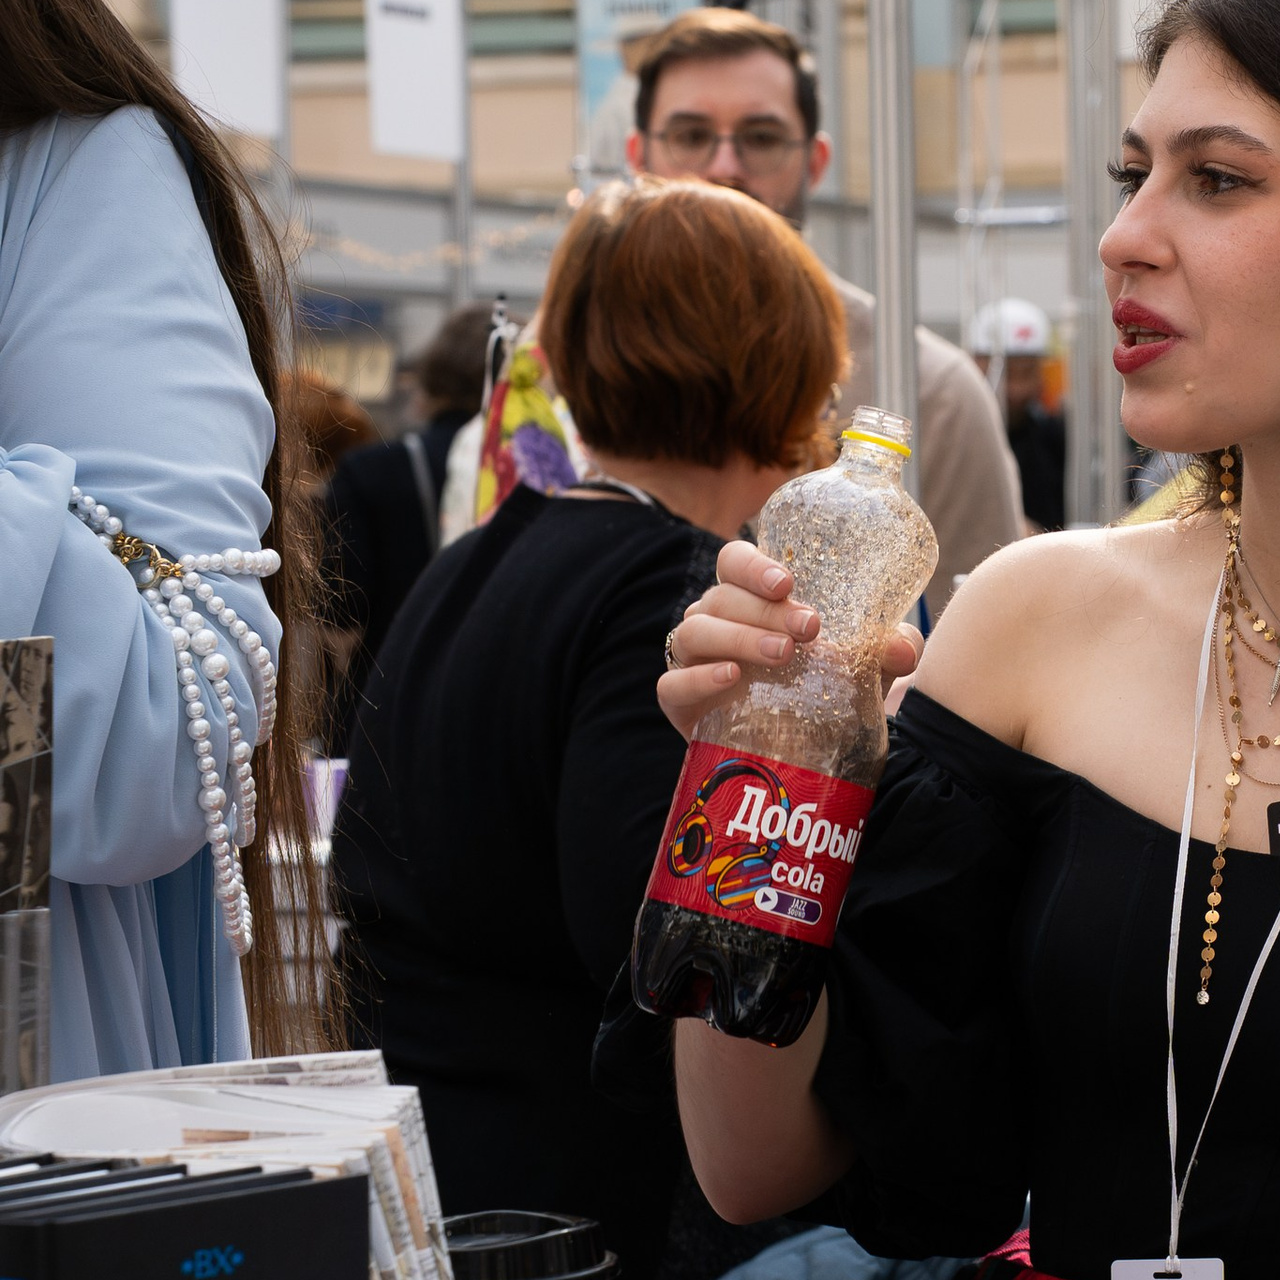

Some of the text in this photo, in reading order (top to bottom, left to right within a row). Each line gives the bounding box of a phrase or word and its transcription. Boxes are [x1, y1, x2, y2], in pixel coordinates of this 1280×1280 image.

[726, 785, 864, 864] Добрый
[771, 861, 825, 894] cola
[791, 898, 807, 911] JAZZ
